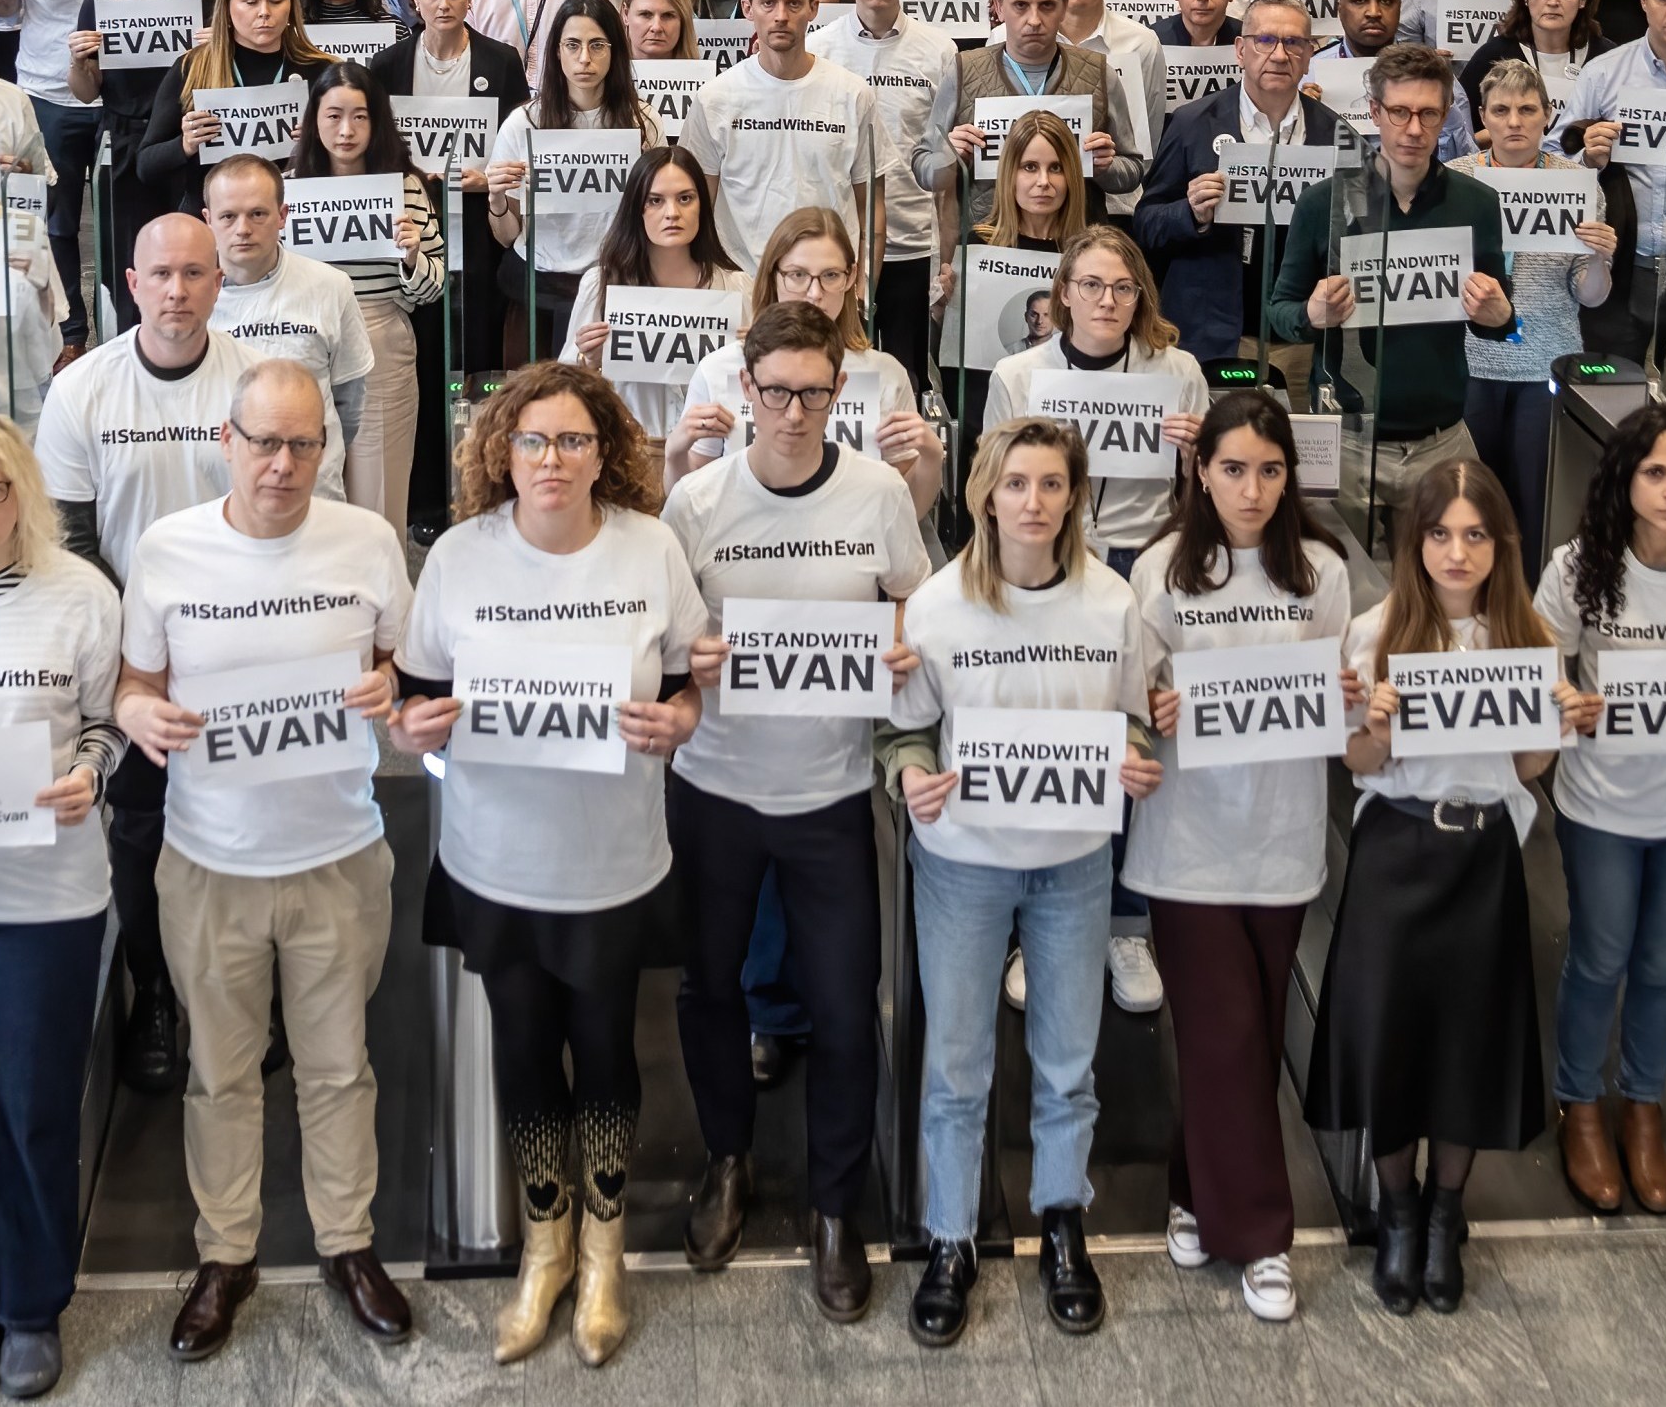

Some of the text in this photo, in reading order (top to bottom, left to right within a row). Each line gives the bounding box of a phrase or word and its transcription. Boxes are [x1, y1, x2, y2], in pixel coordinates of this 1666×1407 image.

[99, 16, 193, 29] #ISTANDWITH
[102, 28, 193, 55] EVAN
[731, 118, 845, 134] #IStandWithEvan
[714, 540, 875, 563] #IStandWithEvan
[476, 600, 647, 622] #IStandWithEvan
[727, 632, 877, 649] #ISTANDWITH
[952, 644, 1117, 669] #IStandWithEvan
[730, 653, 875, 692] EVAN
[1190, 672, 1325, 698] #ISTANDWITH
[1395, 665, 1542, 687] #ISTANDWITH
[470, 678, 612, 698] #ISTANDWITH
[198, 688, 349, 729] #ISTANDWITH
[471, 700, 609, 740] EVAN
[1194, 693, 1325, 737] EVAN
[1396, 687, 1541, 731] EVAN
[206, 708, 347, 763] EVAN
[959, 741, 1109, 762] #ISTANDWITH
[959, 765, 1106, 806] EVAN
